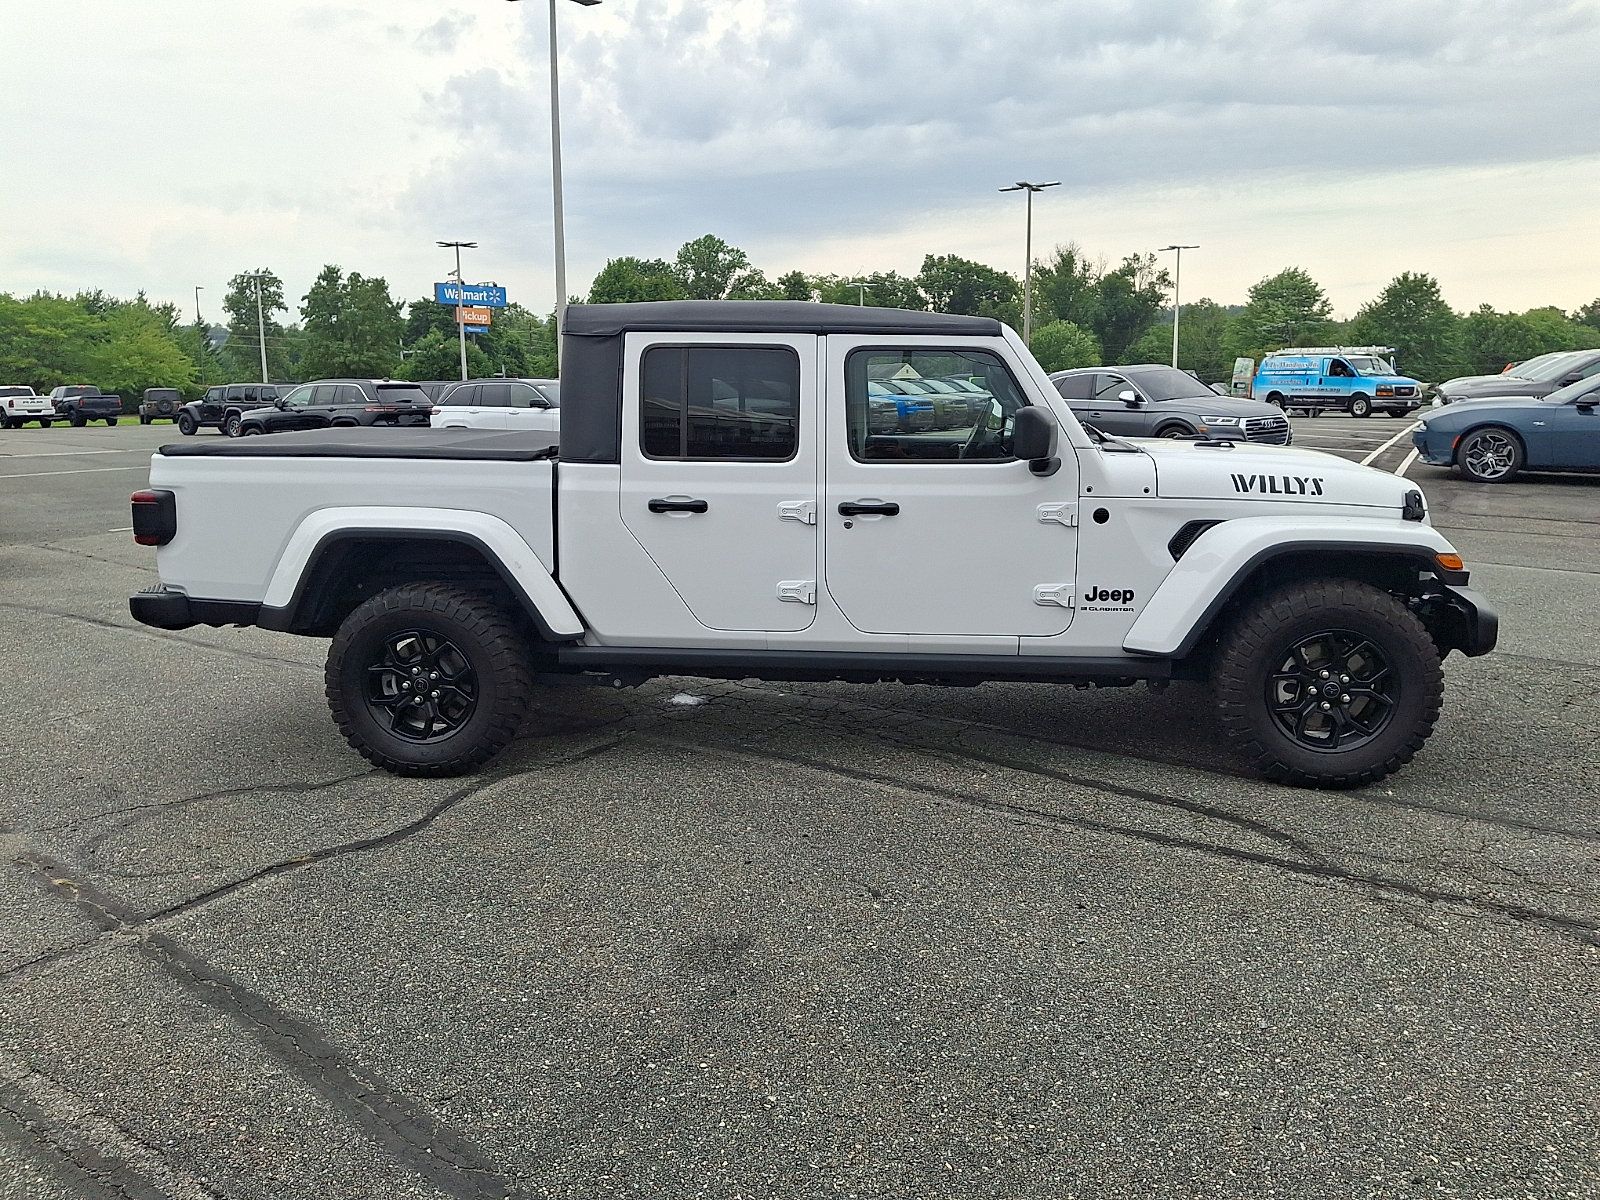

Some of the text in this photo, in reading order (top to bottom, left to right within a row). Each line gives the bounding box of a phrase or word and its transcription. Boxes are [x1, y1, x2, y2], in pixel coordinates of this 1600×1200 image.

[444, 288, 488, 301] Walmart
[1230, 474, 1324, 496] WILLYS
[1084, 586, 1135, 605] Jeep
